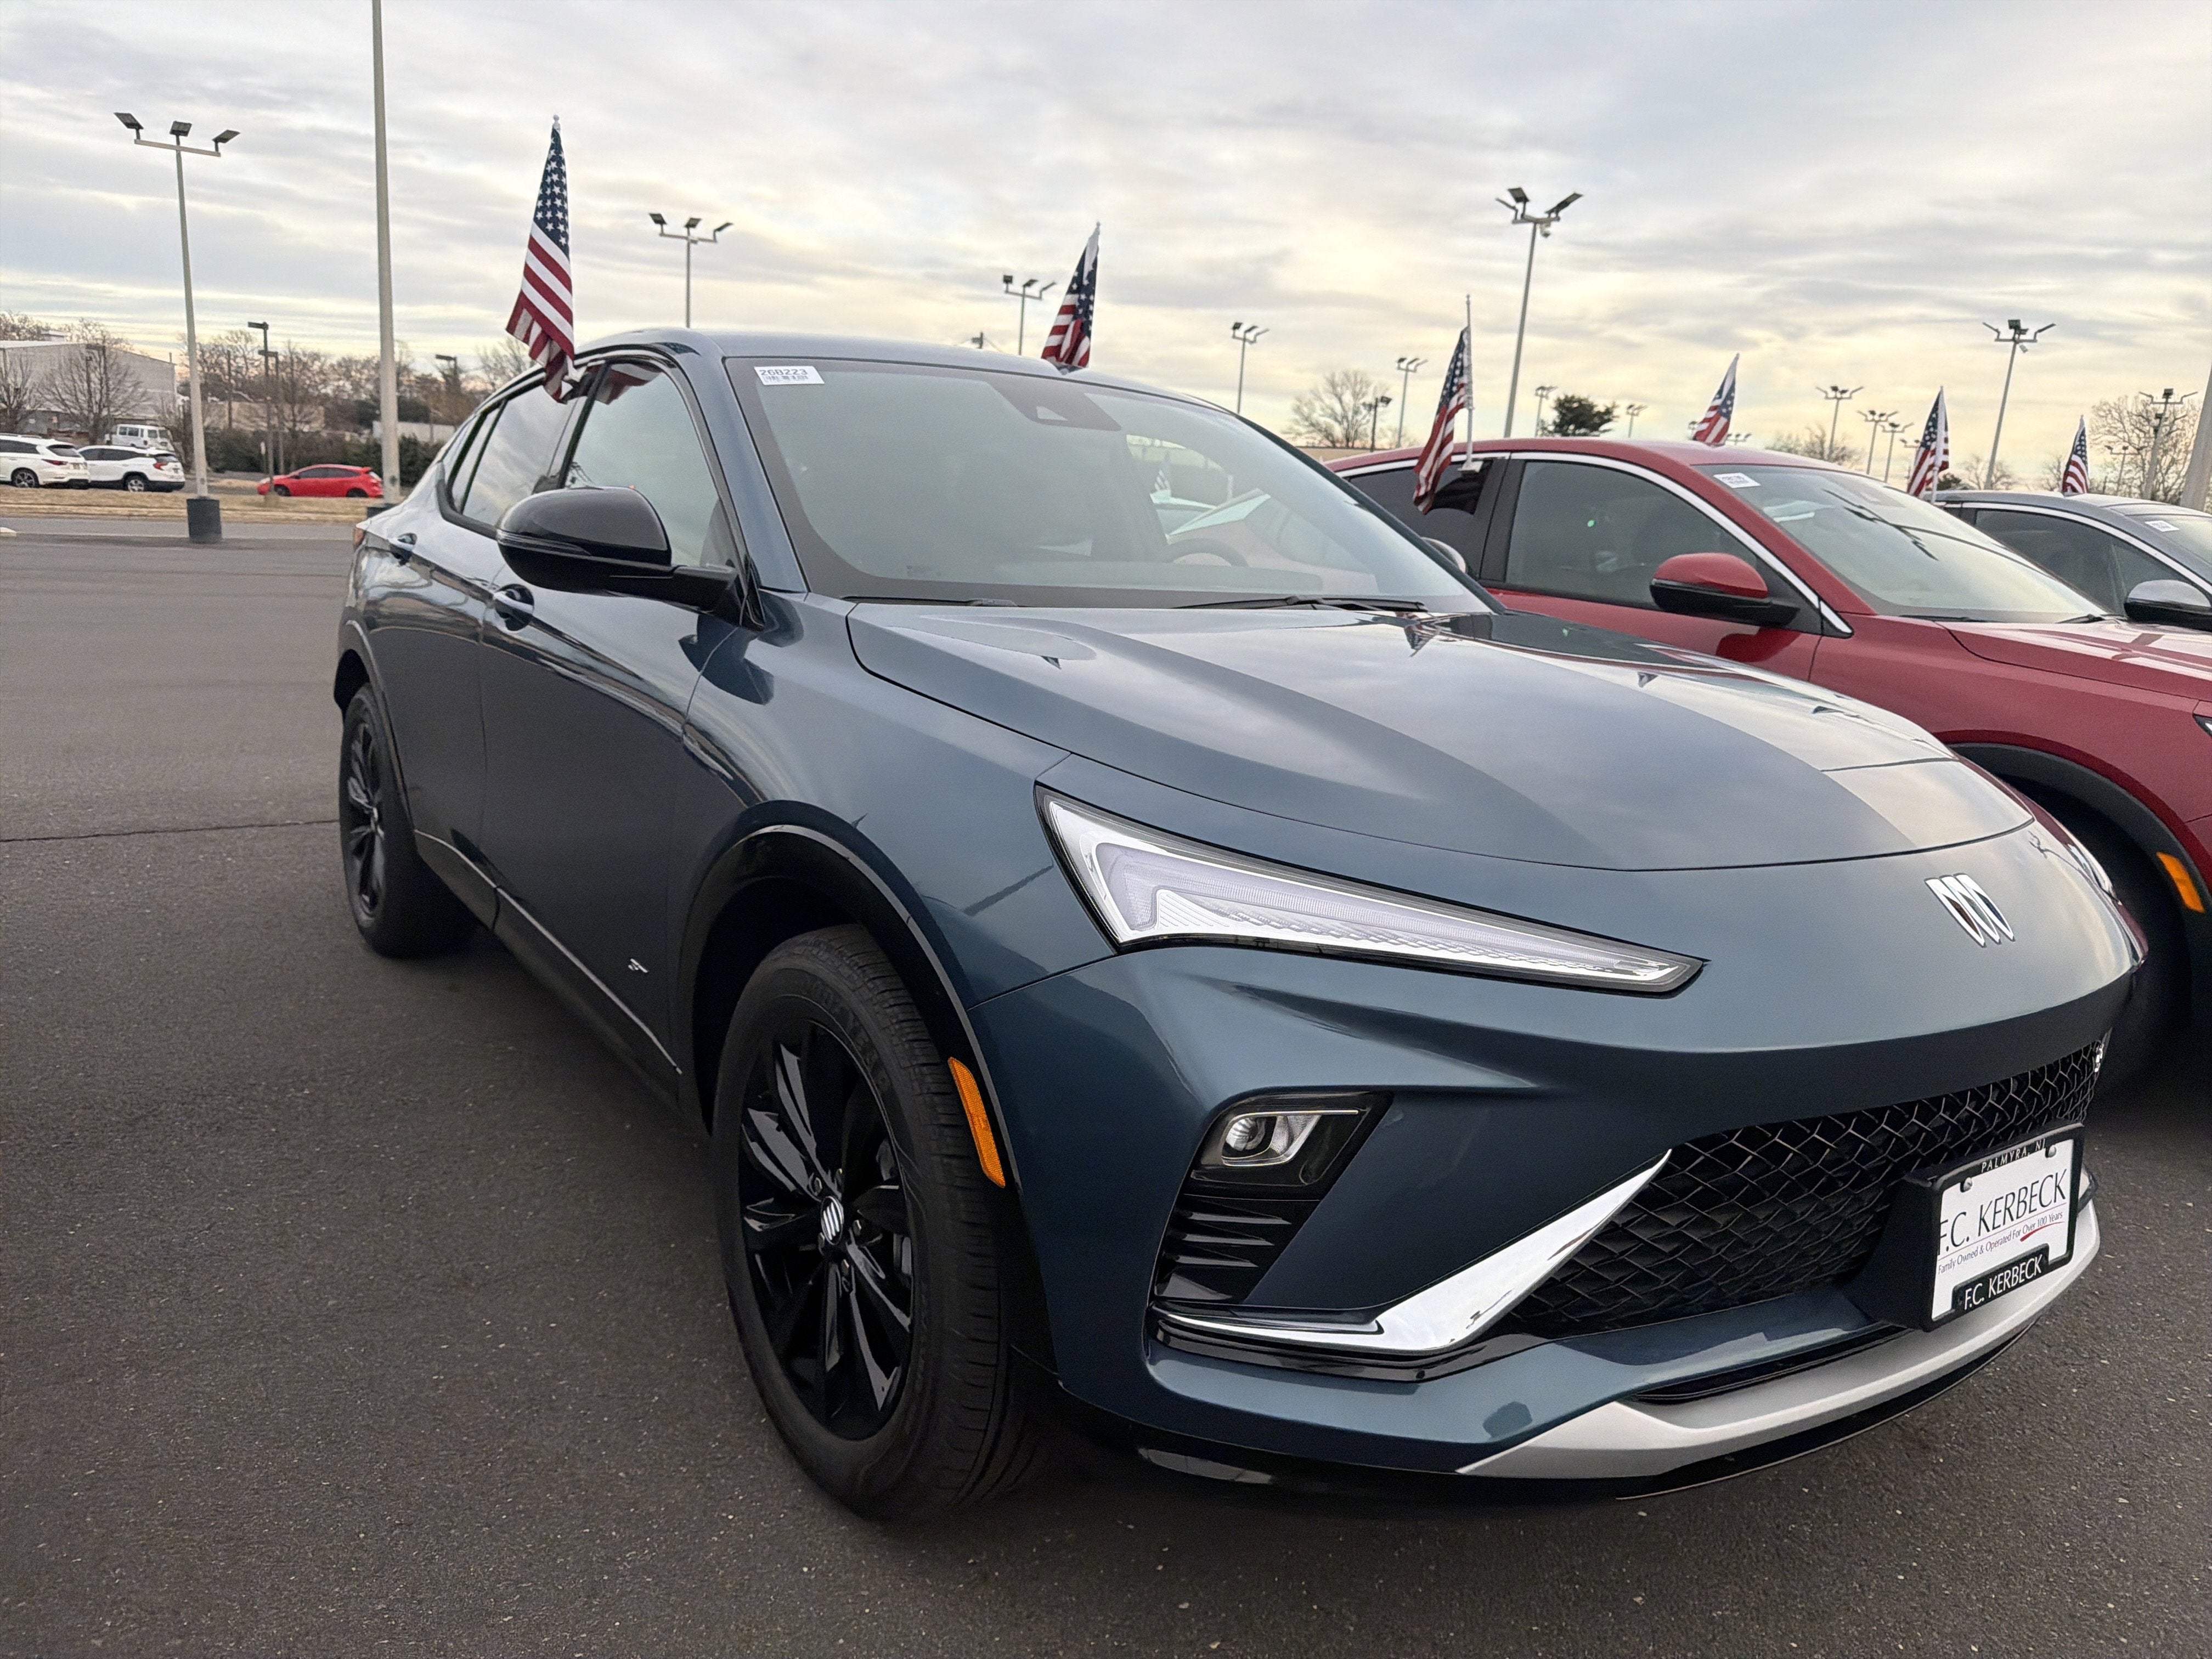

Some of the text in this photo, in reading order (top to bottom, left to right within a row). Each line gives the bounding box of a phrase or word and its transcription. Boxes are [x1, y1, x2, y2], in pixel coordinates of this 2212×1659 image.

[1981, 1147, 2030, 1173] PALMYRA,
[1978, 1169, 2067, 1237] KERBECK
[1938, 1211, 2063, 1275] Family Owned & Operated For Over 100 Years
[1988, 1254, 2043, 1299] KERBECK
